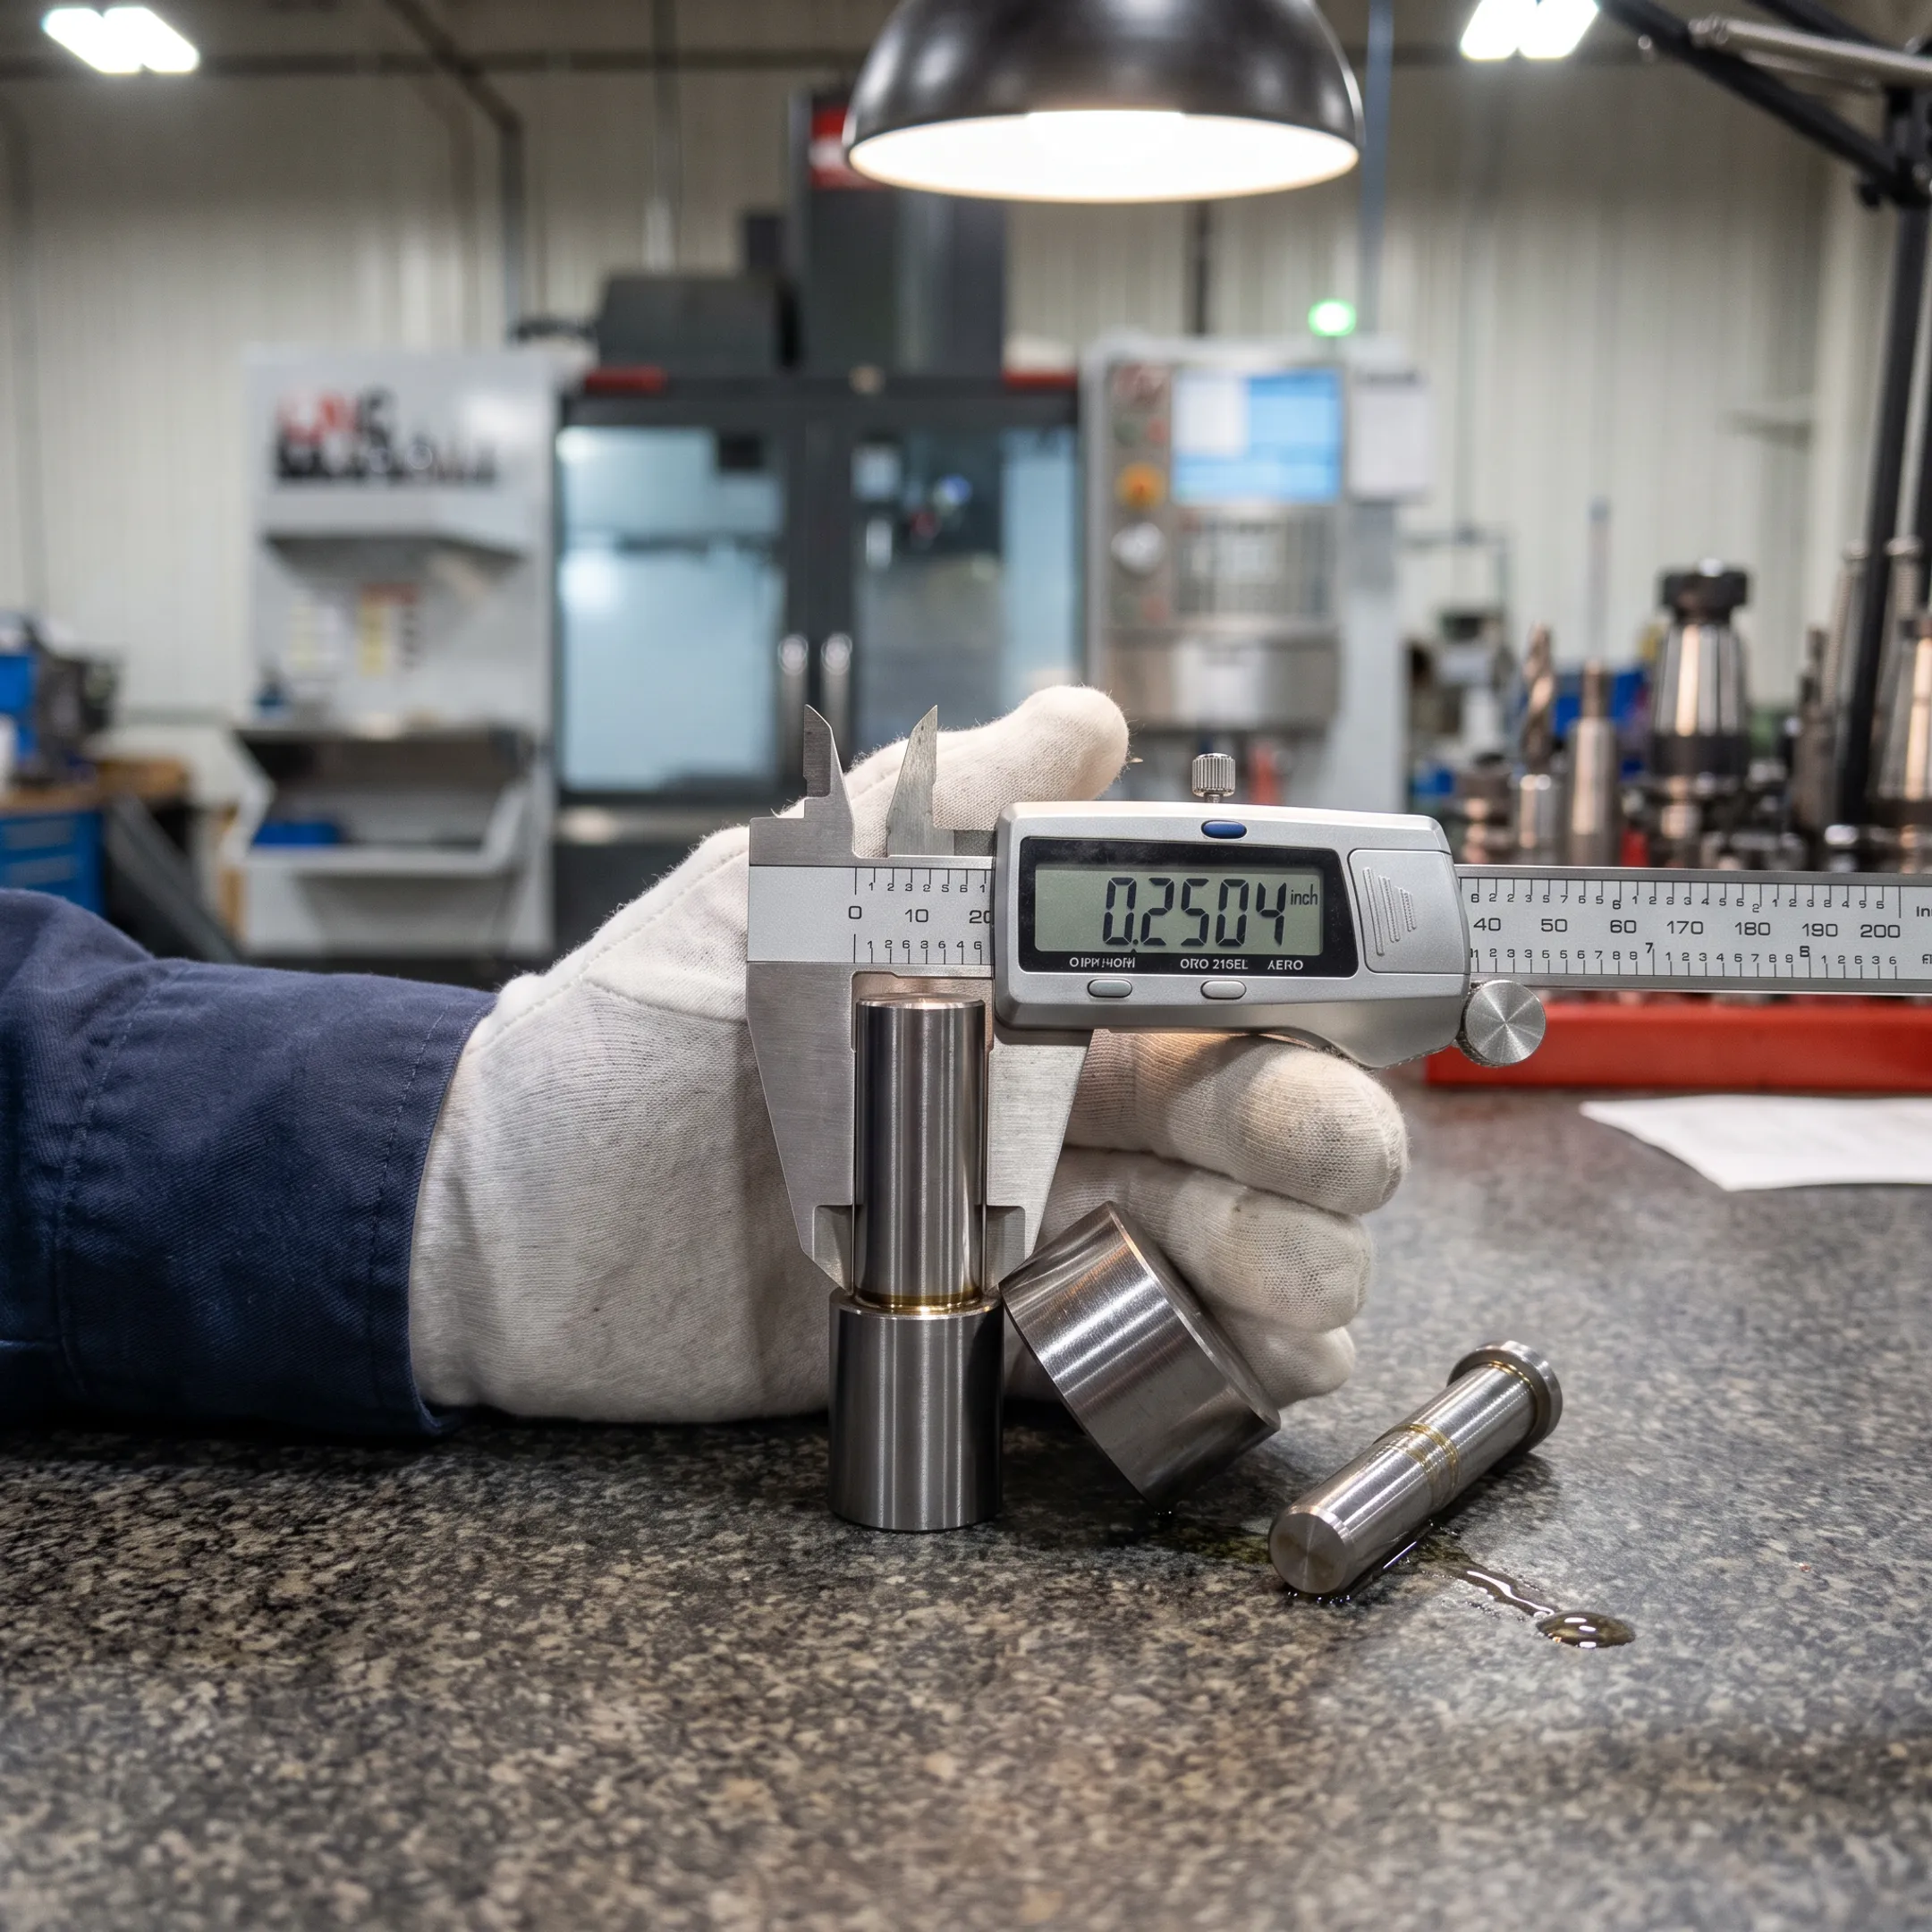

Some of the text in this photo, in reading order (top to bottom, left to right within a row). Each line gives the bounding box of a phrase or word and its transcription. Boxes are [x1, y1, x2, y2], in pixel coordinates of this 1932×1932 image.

[905, 909, 928, 922] 10
[1102, 877, 1318, 946] 0.2504 inch
[1916, 906, 1932, 917] In
[1473, 918, 1901, 938] 40 50 60 170 180 190 200
[1595, 951, 1603, 959] 7
[1646, 943, 1654, 953] 7
[1682, 953, 1690, 961] 2
[1699, 953, 1707, 962] 3
[1716, 953, 1724, 962] 4
[1751, 953, 1758, 962] 7
[1838, 955, 1845, 964] 2
[1872, 956, 1880, 964] 3
[1267, 960, 1303, 970] AERO
